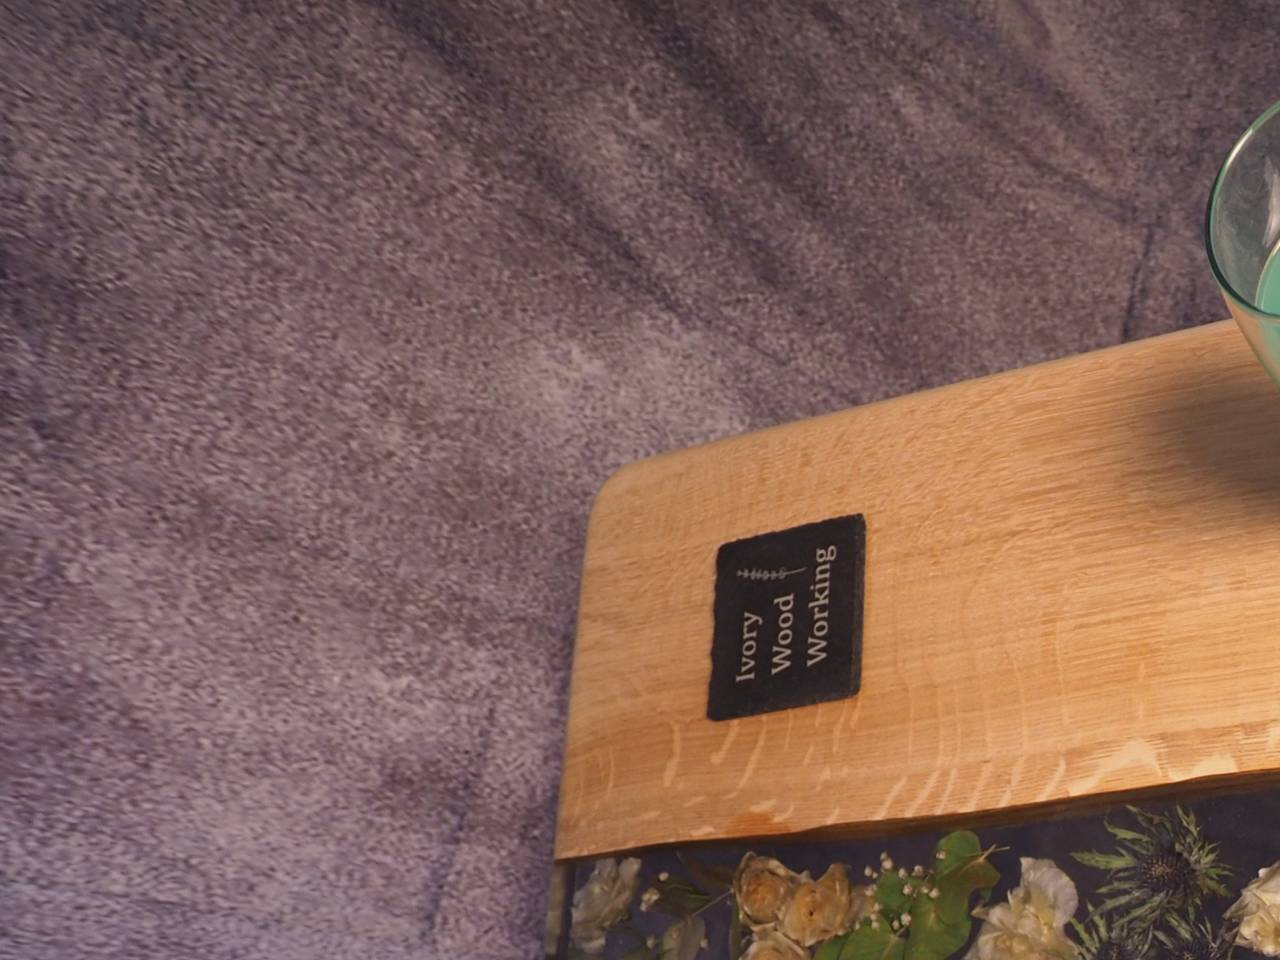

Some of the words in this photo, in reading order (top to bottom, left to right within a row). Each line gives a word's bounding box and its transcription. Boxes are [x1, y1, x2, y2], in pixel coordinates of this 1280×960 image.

[736, 612, 763, 682] Ivory
[771, 593, 795, 675] Wood
[806, 545, 837, 668] Working
